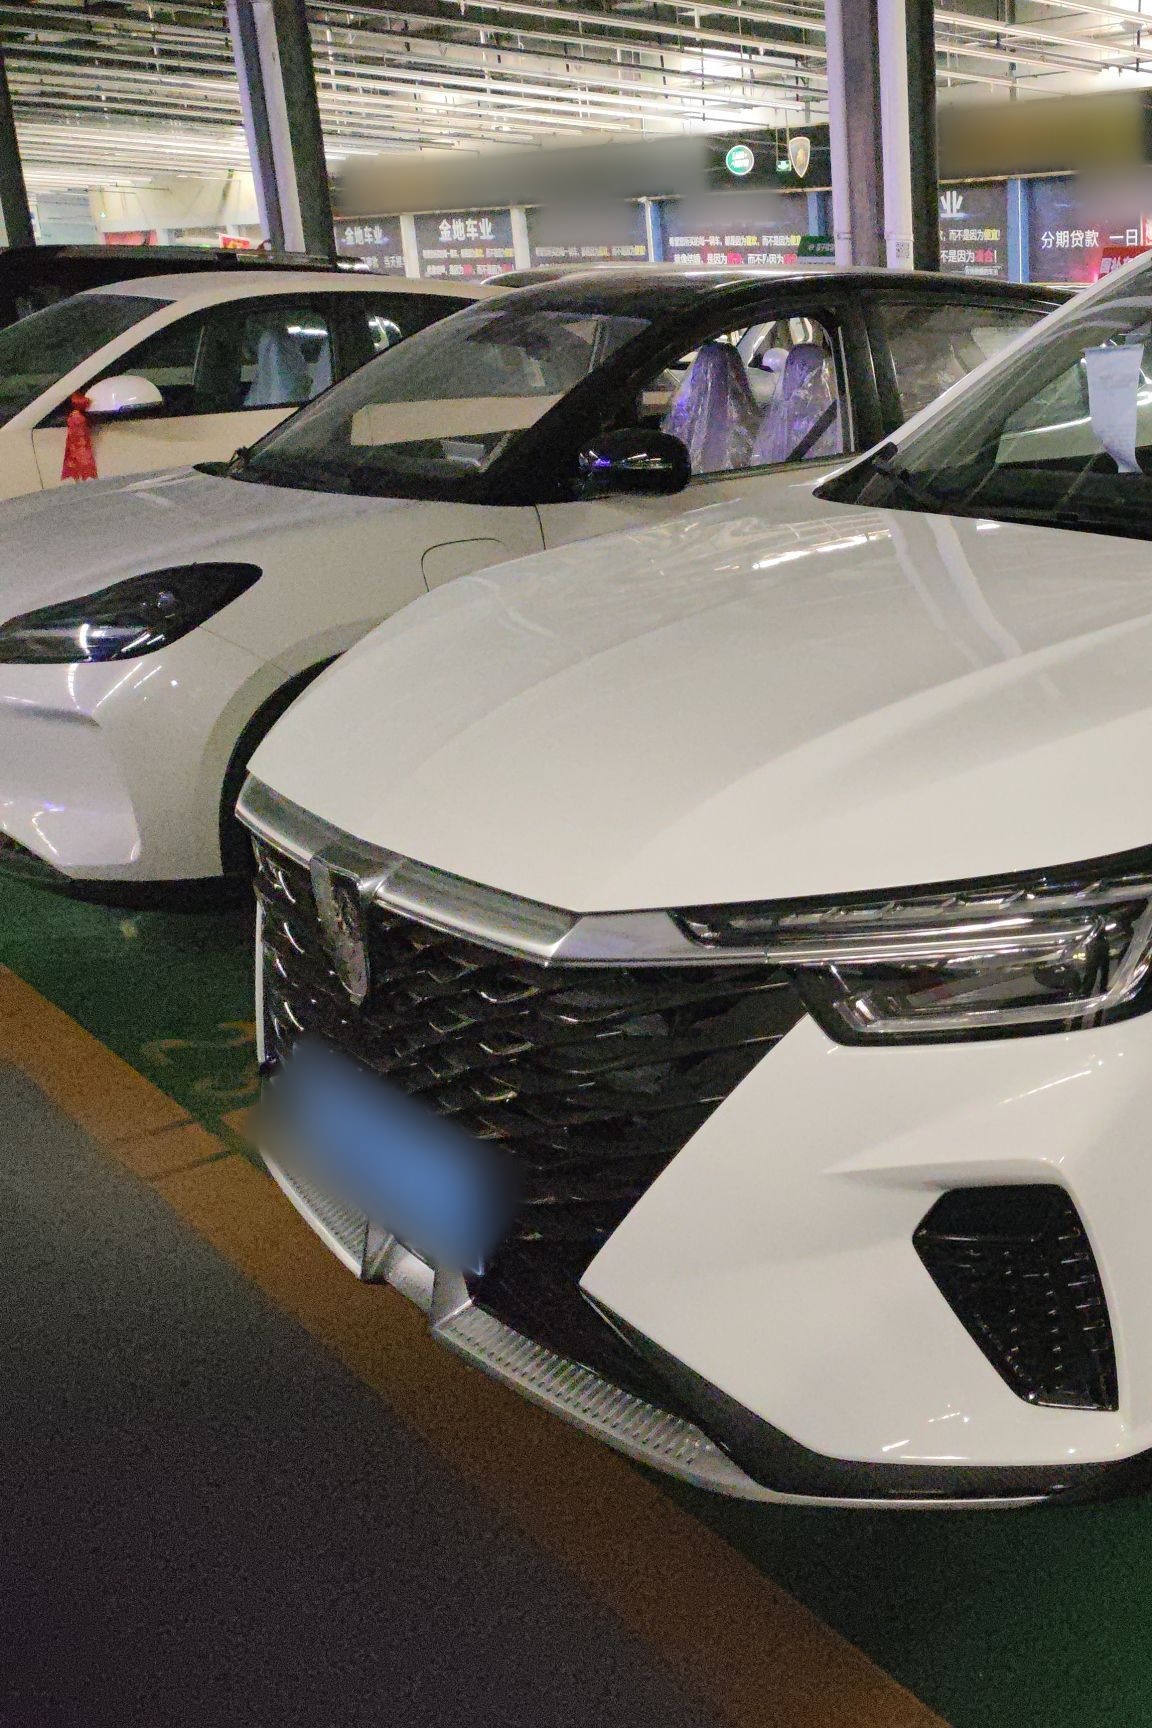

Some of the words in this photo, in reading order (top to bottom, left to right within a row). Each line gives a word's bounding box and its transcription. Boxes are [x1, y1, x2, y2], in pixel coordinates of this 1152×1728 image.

[438, 217, 494, 242] 金地车业
[1040, 230, 1100, 249] 分期贷款
